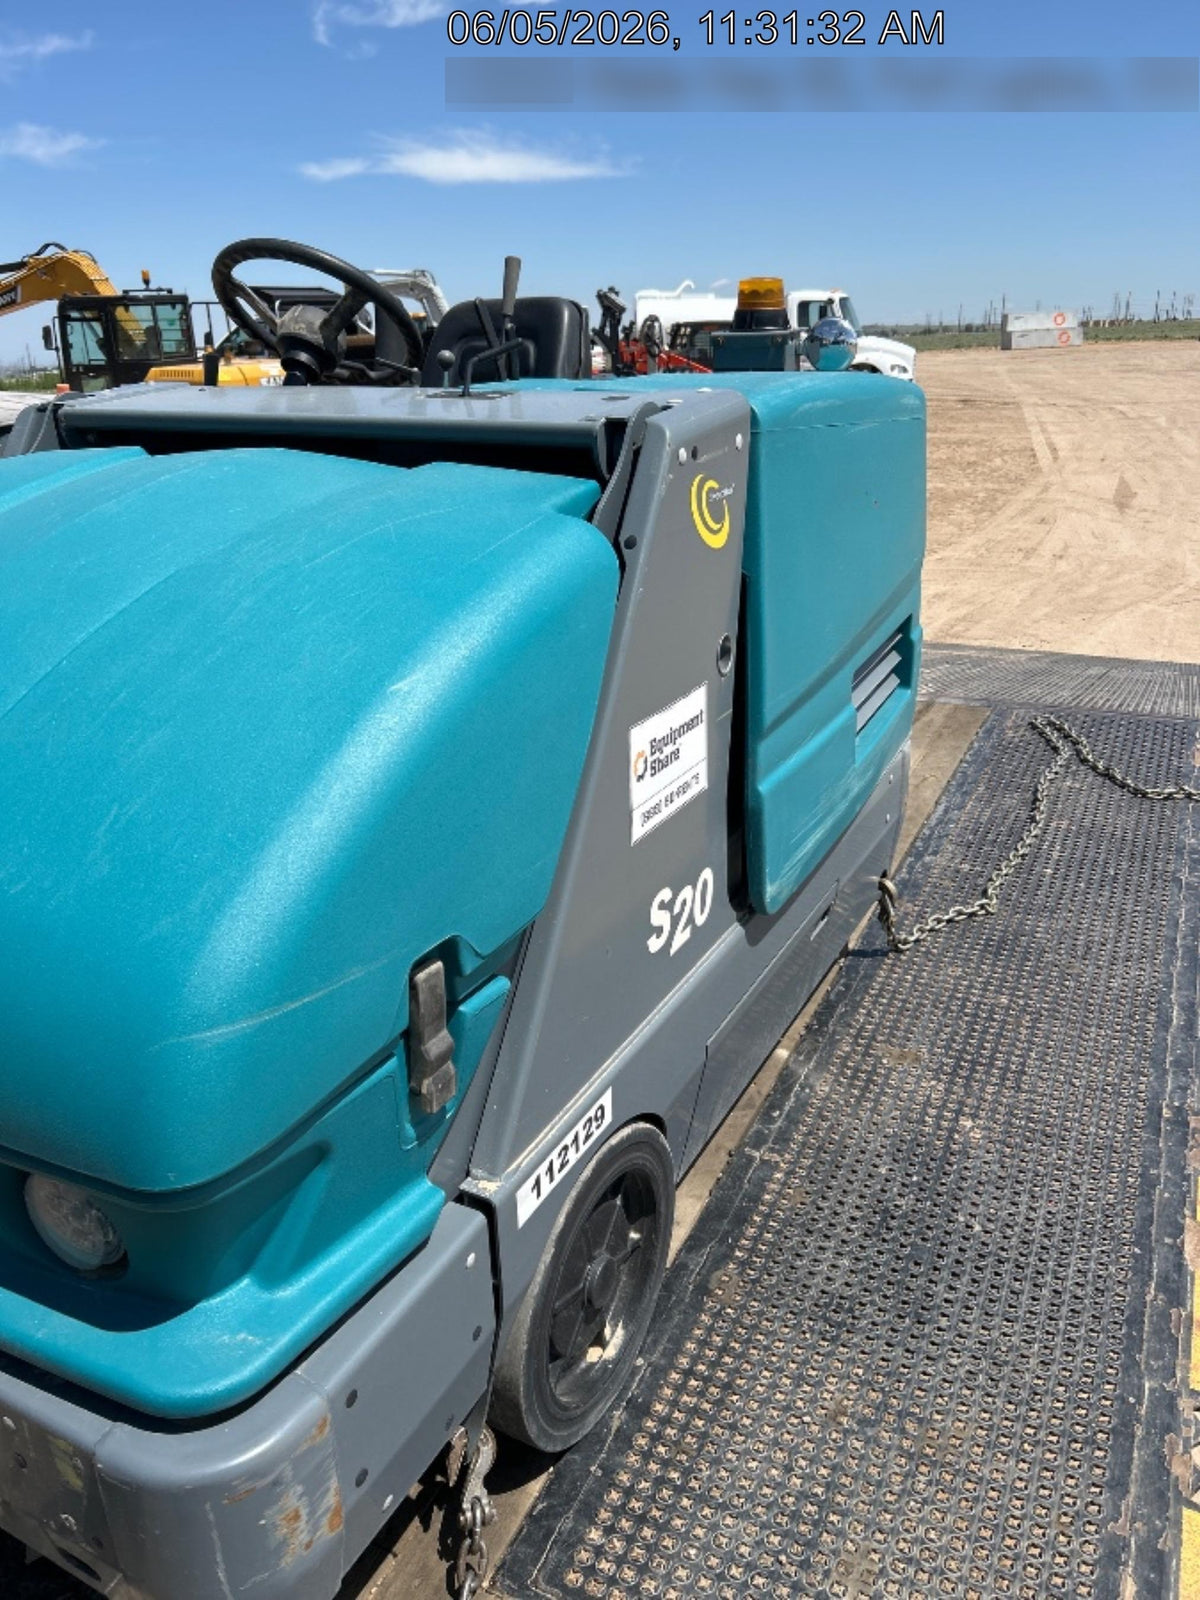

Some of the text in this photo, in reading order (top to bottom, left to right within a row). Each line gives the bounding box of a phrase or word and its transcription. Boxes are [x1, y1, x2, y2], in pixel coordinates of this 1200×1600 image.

[650, 709, 704, 756] Equipment
[650, 747, 680, 778] Share
[647, 867, 713, 956] S20
[530, 1104, 606, 1201] 112129
